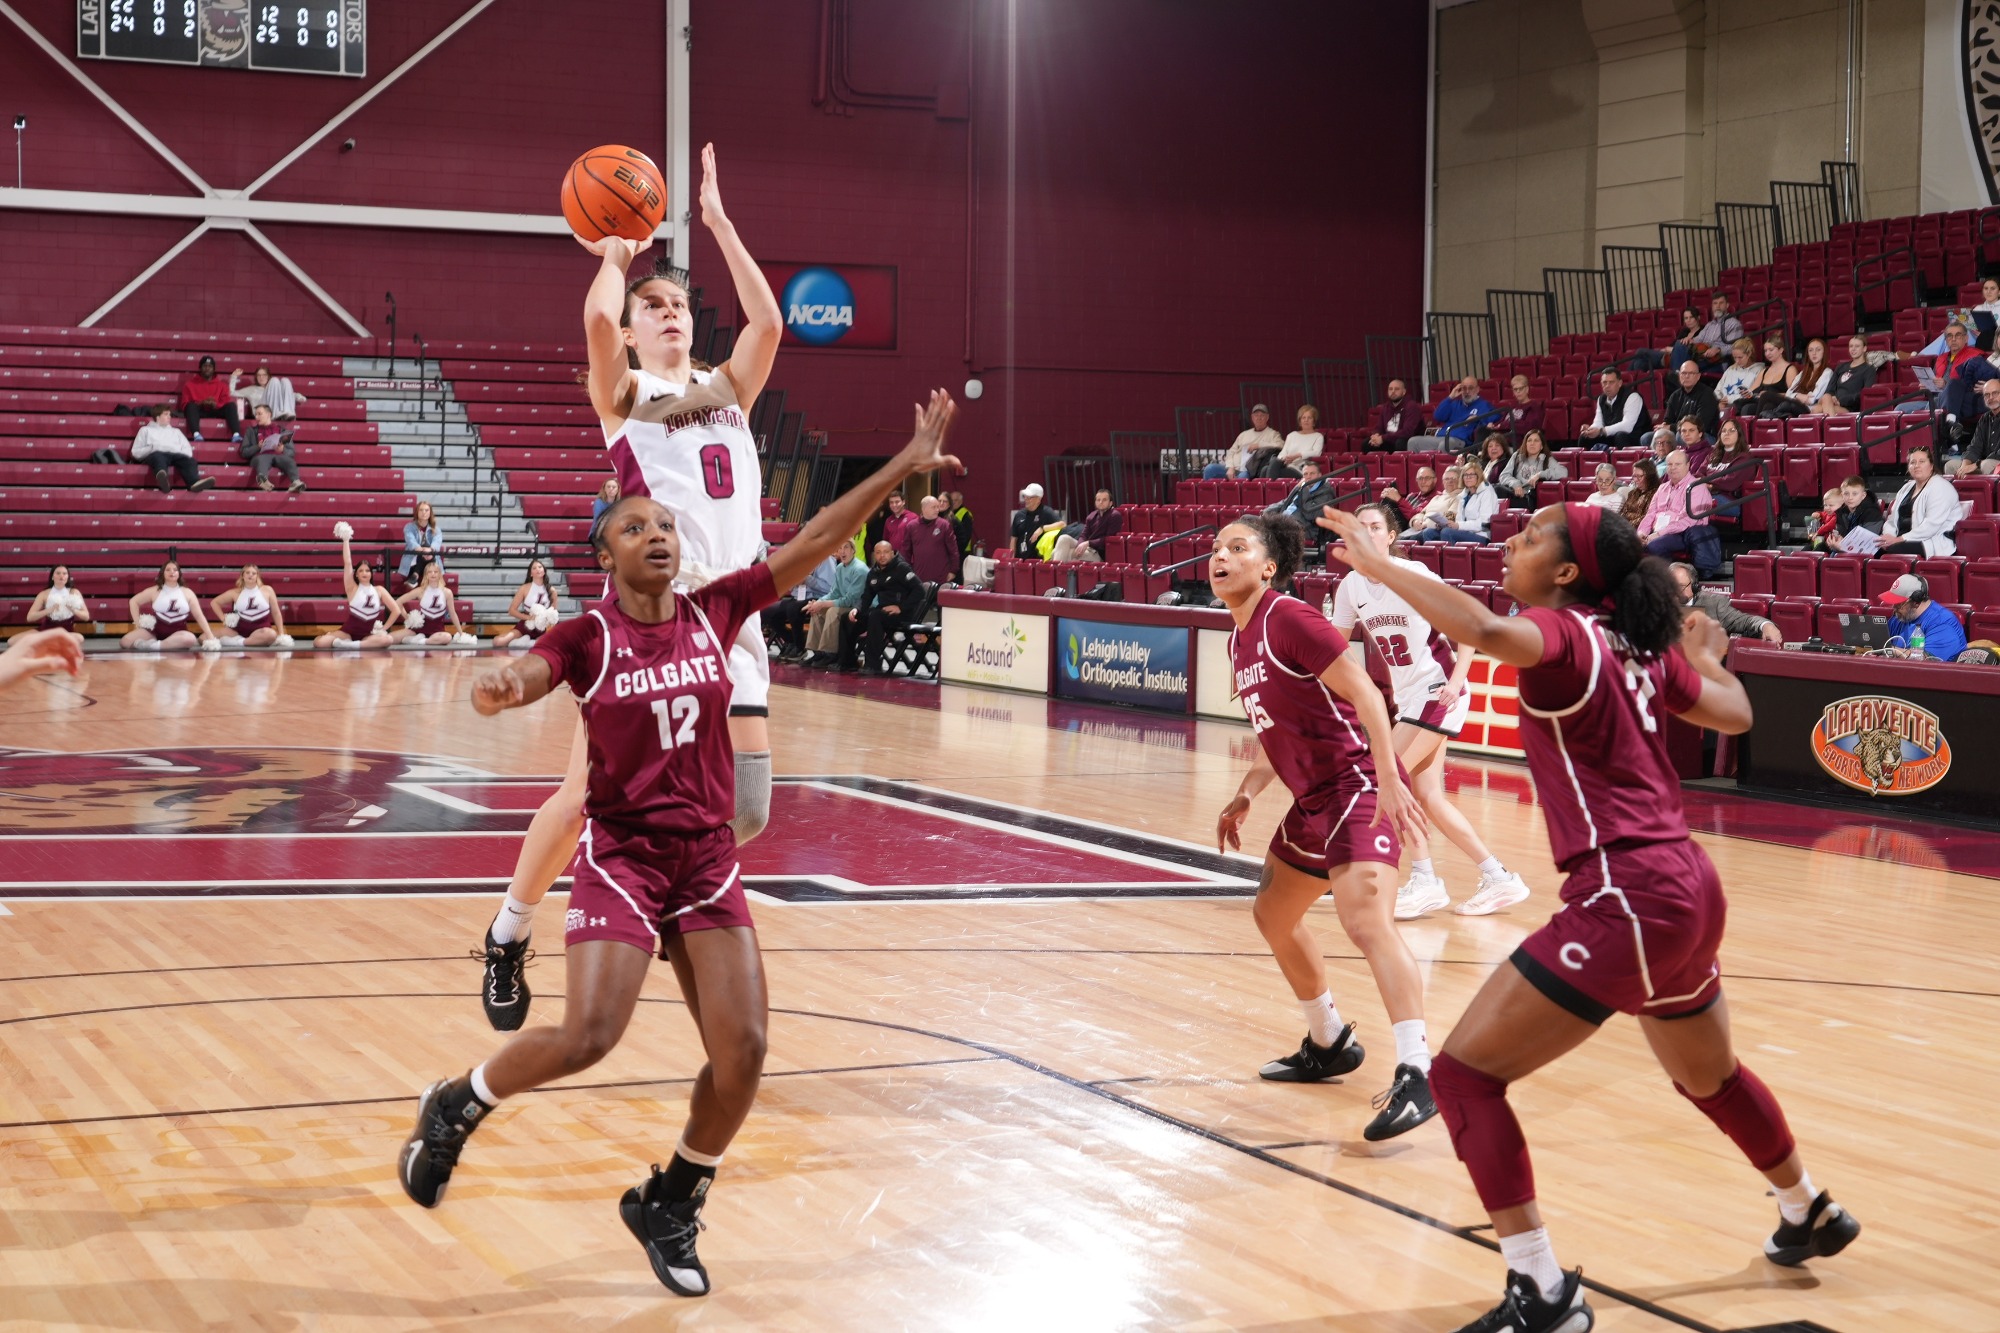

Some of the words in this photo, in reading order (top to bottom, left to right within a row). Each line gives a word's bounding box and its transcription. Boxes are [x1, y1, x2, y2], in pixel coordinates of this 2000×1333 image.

[82, 0, 98, 35] LAF
[153, 0, 165, 15] 0
[183, 0, 195, 17] 0
[262, 5, 280, 24] 12
[297, 7, 309, 26] 0
[326, 9, 338, 28] 0
[110, 13, 134, 32] 24
[153, 17, 165, 36] 0
[183, 19, 195, 38] 2
[256, 24, 279, 44] 25
[297, 27, 309, 46] 0
[326, 29, 338, 48] 0
[613, 165, 660, 210] ELITE
[787, 303, 853, 327] NCAA
[663, 405, 745, 438] LAFAYETTE
[699, 443, 735, 499] 0
[167, 599, 180, 612] L
[246, 597, 259, 610] L
[362, 595, 375, 608] L
[429, 595, 442, 608] L
[967, 641, 1013, 668] Astound
[1081, 637, 1118, 664] Lehigh
[1119, 640, 1151, 669] Valley
[1375, 634, 1413, 666] 22
[615, 655, 719, 697] COLGATE
[1081, 661, 1142, 691] Orthopedic
[1143, 668, 1187, 694] Institute
[651, 695, 700, 750] 12
[1244, 692, 1275, 734] 25
[1826, 699, 1938, 753] LAFAYETTE
[1822, 745, 1861, 783] SPORTS
[1897, 754, 1947, 788] NETWORK
[1374, 835, 1390, 853] C
[1559, 941, 1591, 970] C
